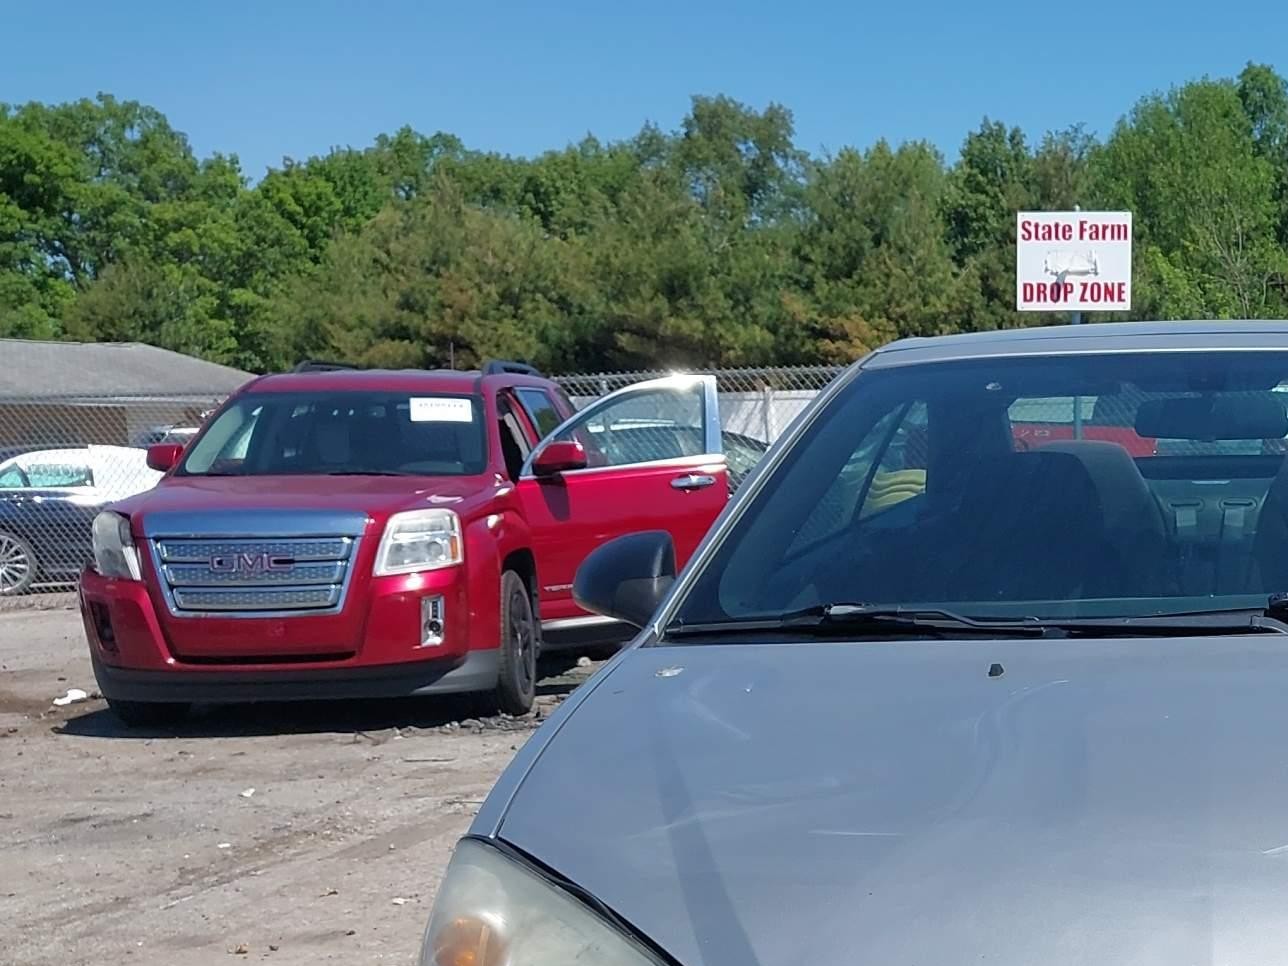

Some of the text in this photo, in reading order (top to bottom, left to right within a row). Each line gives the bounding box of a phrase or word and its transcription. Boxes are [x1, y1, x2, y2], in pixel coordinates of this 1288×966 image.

[1021, 220, 1128, 241] State Farm
[1022, 282, 1126, 303] DROP ZONE
[210, 553, 295, 573] GMC
